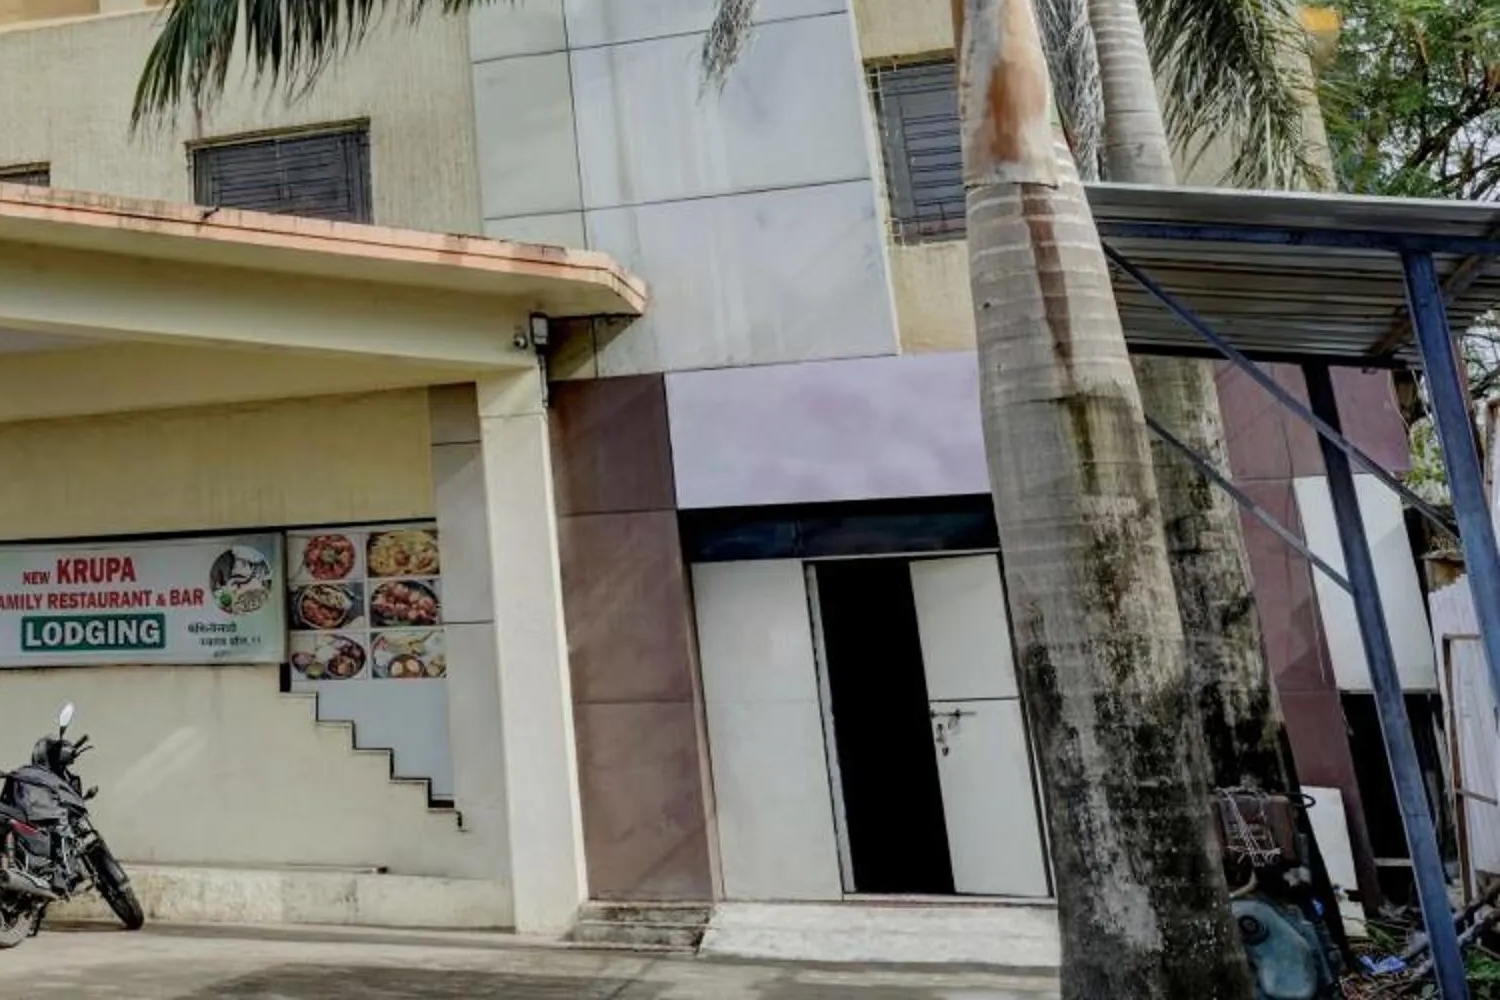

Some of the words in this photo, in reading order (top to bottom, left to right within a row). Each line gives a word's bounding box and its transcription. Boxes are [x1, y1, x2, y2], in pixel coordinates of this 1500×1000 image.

[23, 571, 50, 585] NEW
[57, 557, 137, 584] KRUPA
[47, 589, 153, 609] RESTAURANT
[156, 593, 167, 606] &
[170, 587, 205, 606] BAR
[25, 619, 161, 647] LODGING
